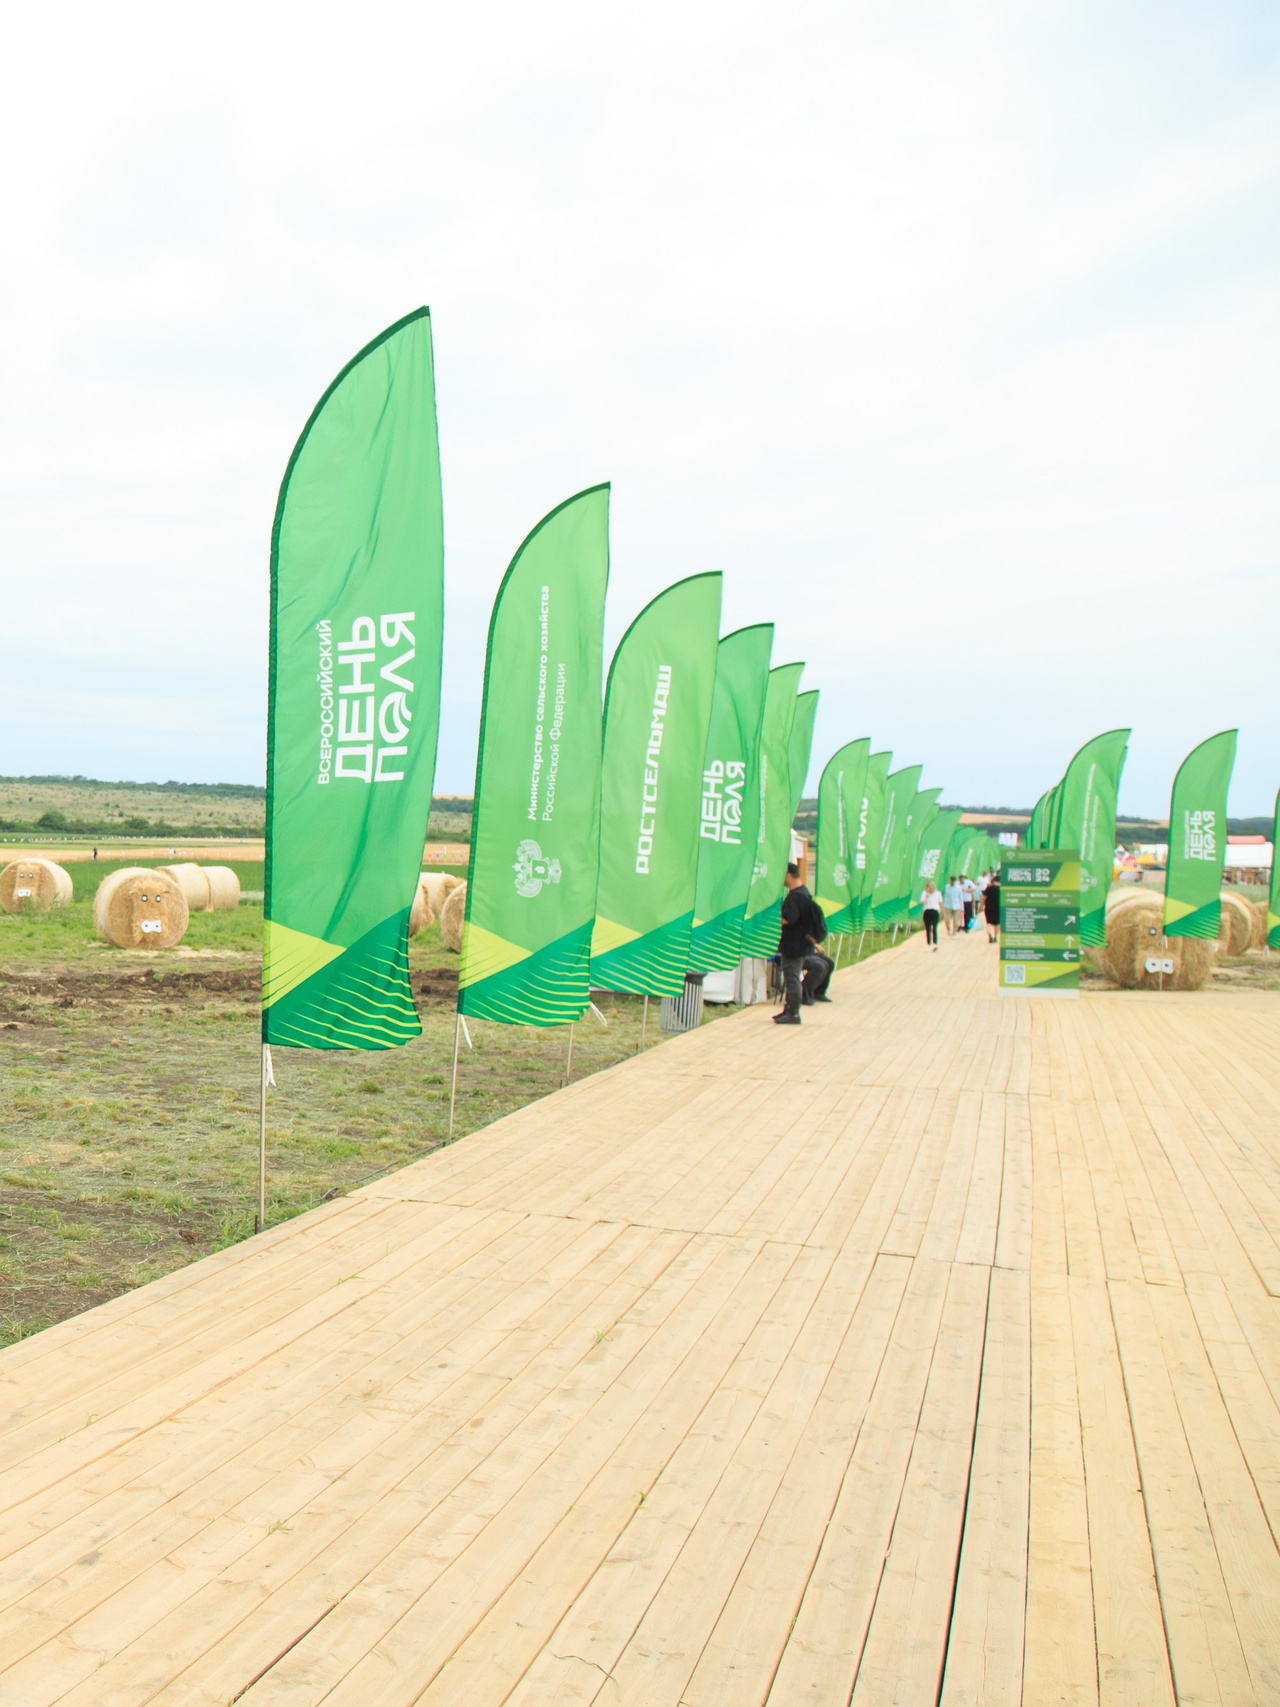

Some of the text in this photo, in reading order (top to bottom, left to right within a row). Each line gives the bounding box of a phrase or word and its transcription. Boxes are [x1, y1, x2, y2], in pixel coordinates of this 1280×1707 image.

[316, 619, 334, 784] ВСЕРОССИЙСКИЙ
[334, 616, 376, 783] ДЕНЬ
[373, 611, 416, 782] ПОЛЯ
[527, 585, 550, 821] Министерство сельского хозяйства
[541, 663, 566, 821] Российской Федерации
[635, 665, 672, 874] РОСТСЕЛЬМАШ
[699, 760, 724, 842] ДЕНЬ
[721, 761, 746, 844] ПОЛЯ
[1190, 810, 1203, 860] ДЕНЬ
[1202, 811, 1217, 861] ПОЛЯ
